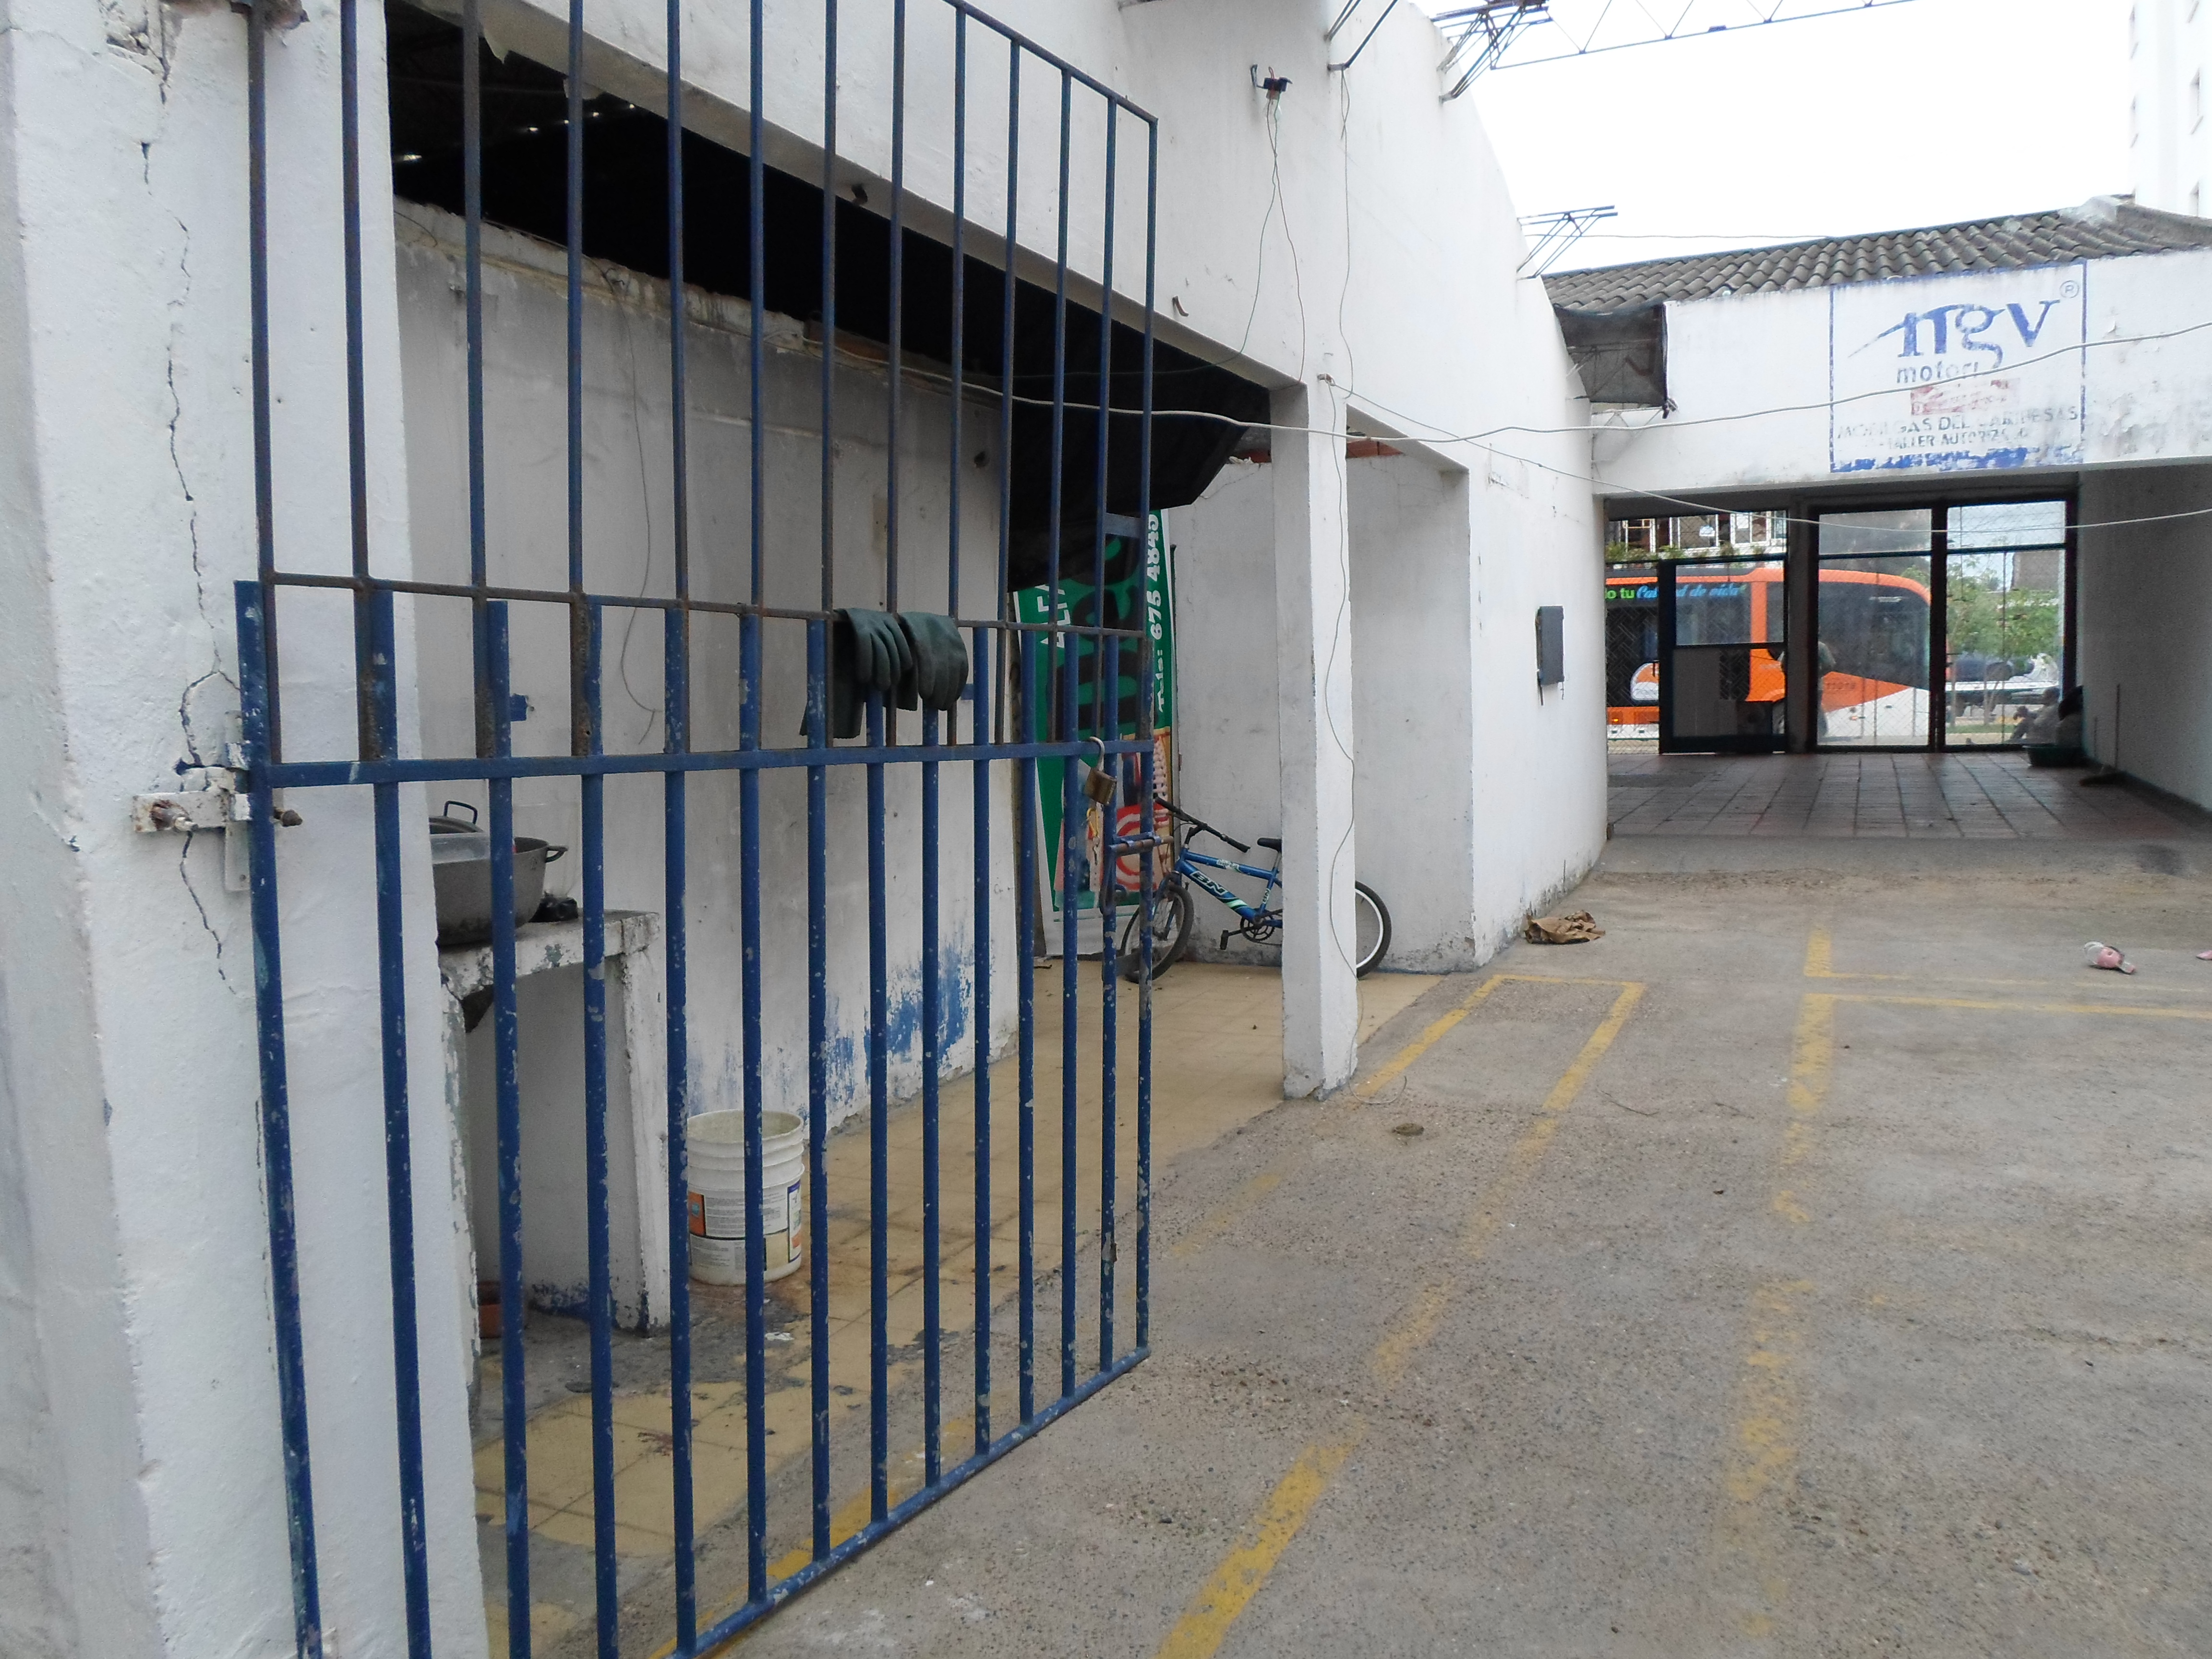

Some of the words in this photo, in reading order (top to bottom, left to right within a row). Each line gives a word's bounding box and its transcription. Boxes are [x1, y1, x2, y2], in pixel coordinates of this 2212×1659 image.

[1849, 299, 2060, 369] ngv
[1146, 589, 1162, 640] 675
[1620, 579, 1635, 599] tu
[1689, 583, 1707, 597] de
